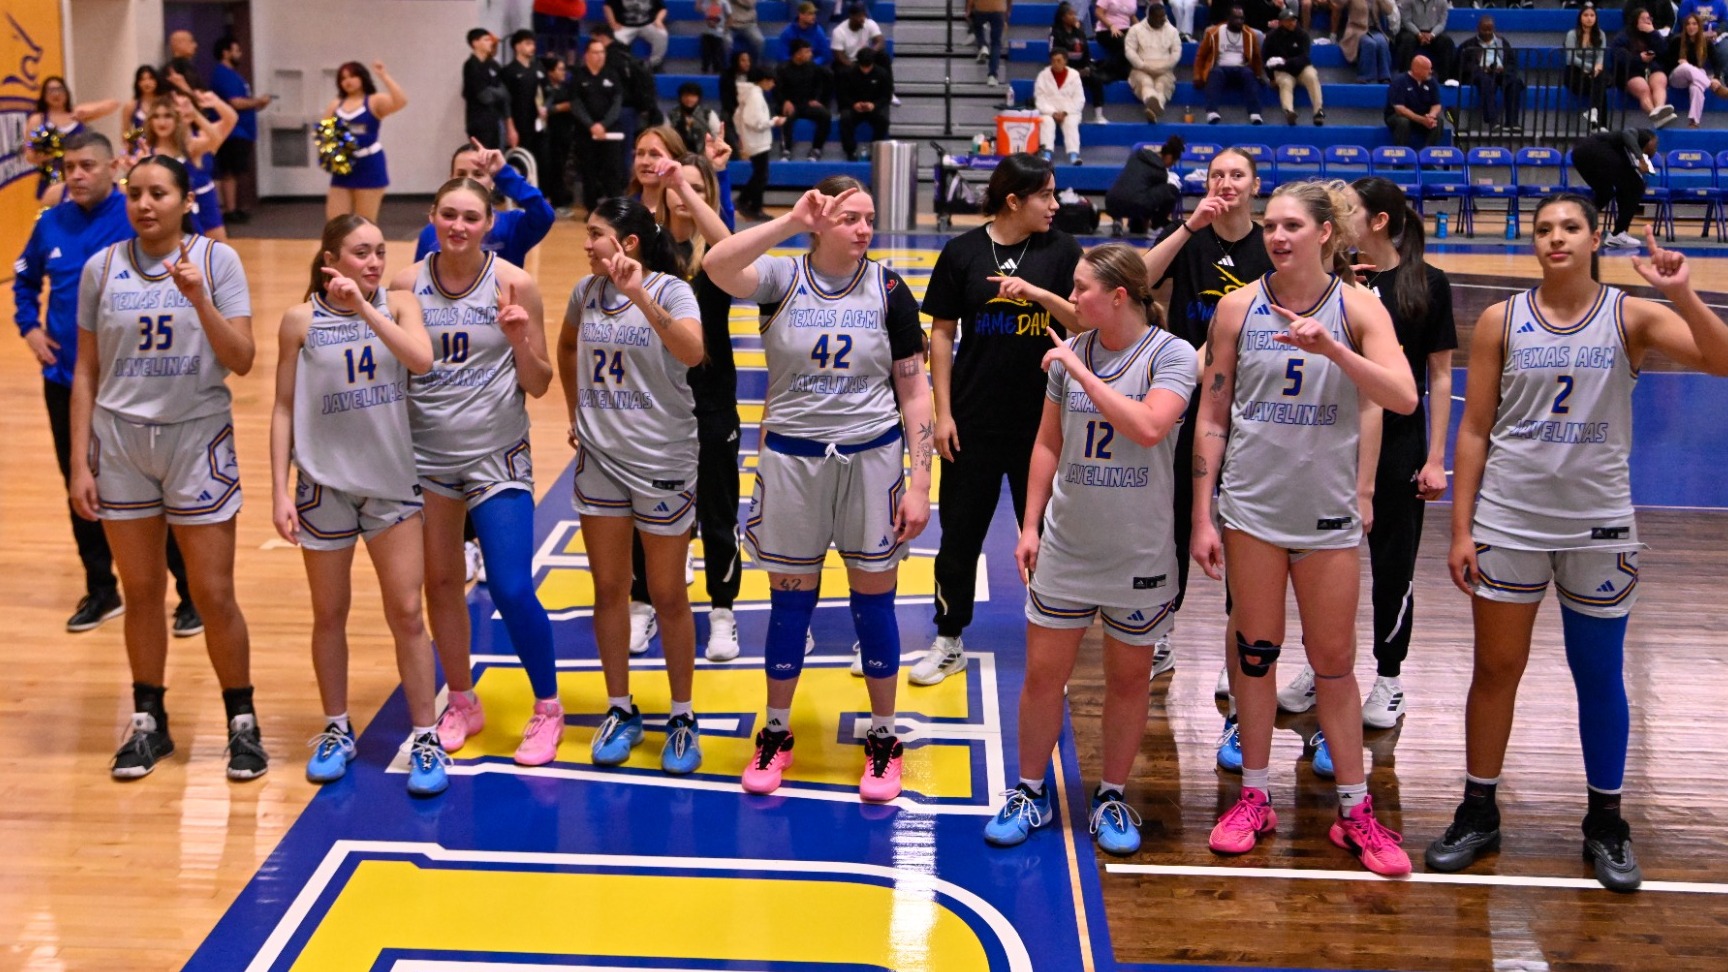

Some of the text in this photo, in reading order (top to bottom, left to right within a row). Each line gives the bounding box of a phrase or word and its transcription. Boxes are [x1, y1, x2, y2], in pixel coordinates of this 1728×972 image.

[111, 289, 161, 312] TEXAS
[138, 315, 173, 351] 35
[841, 309, 878, 329] A&M
[307, 321, 360, 349] TEXAS
[441, 331, 469, 364] 10
[614, 325, 651, 347] A&M
[1247, 330, 1299, 351] TEXA
[115, 356, 200, 377] JAVELINAS
[344, 345, 377, 384] 14
[593, 349, 625, 384] 24
[811, 334, 853, 369] 42
[1513, 346, 1616, 370] TEXAS A&M
[1282, 358, 1305, 397] 5
[322, 382, 406, 415] JAVELINAS
[1551, 375, 1574, 414] 2
[1243, 400, 1338, 425] JAVELINAS
[1084, 420, 1115, 460] 12
[780, 578, 802, 591] 42
